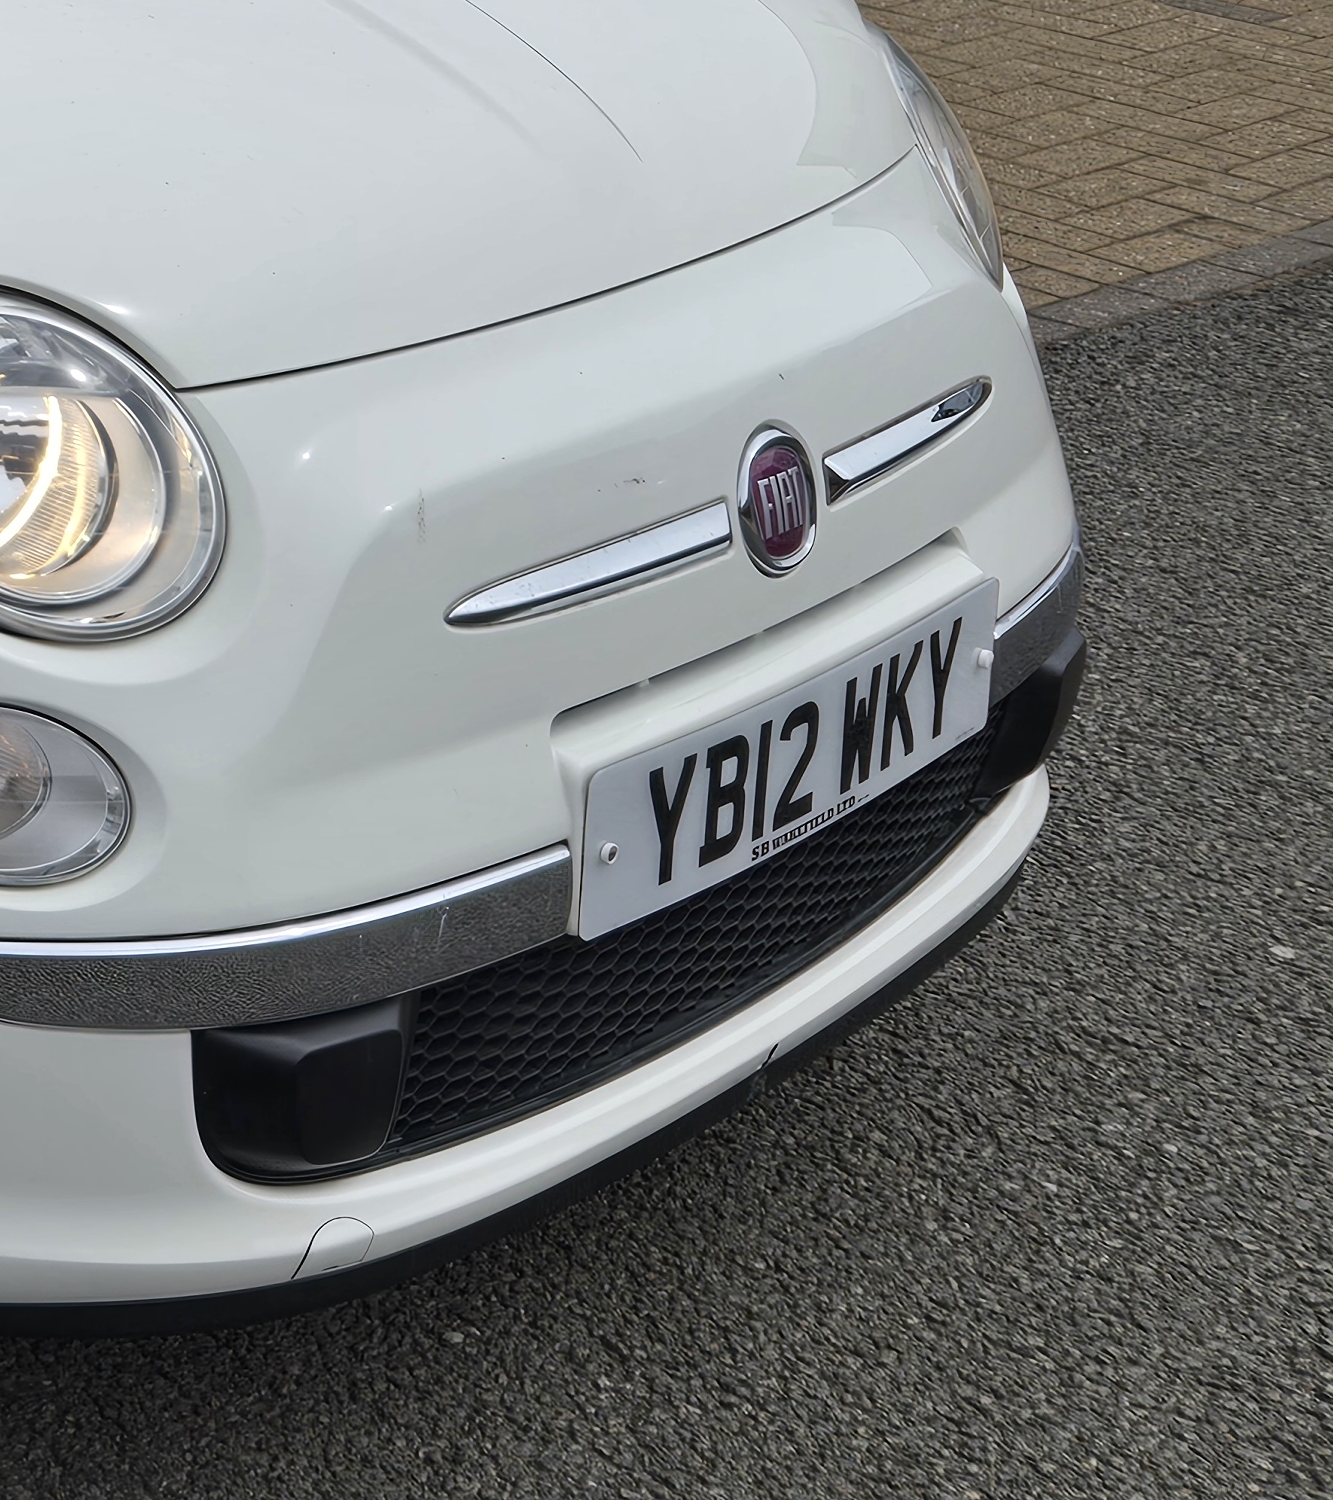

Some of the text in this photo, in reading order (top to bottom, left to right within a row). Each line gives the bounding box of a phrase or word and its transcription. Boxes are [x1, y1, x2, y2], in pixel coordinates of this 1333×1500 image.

[757, 465, 803, 540] FIAT
[649, 616, 963, 886] YB12 WKY
[751, 840, 770, 862] SB
[836, 795, 856, 816] LTD
